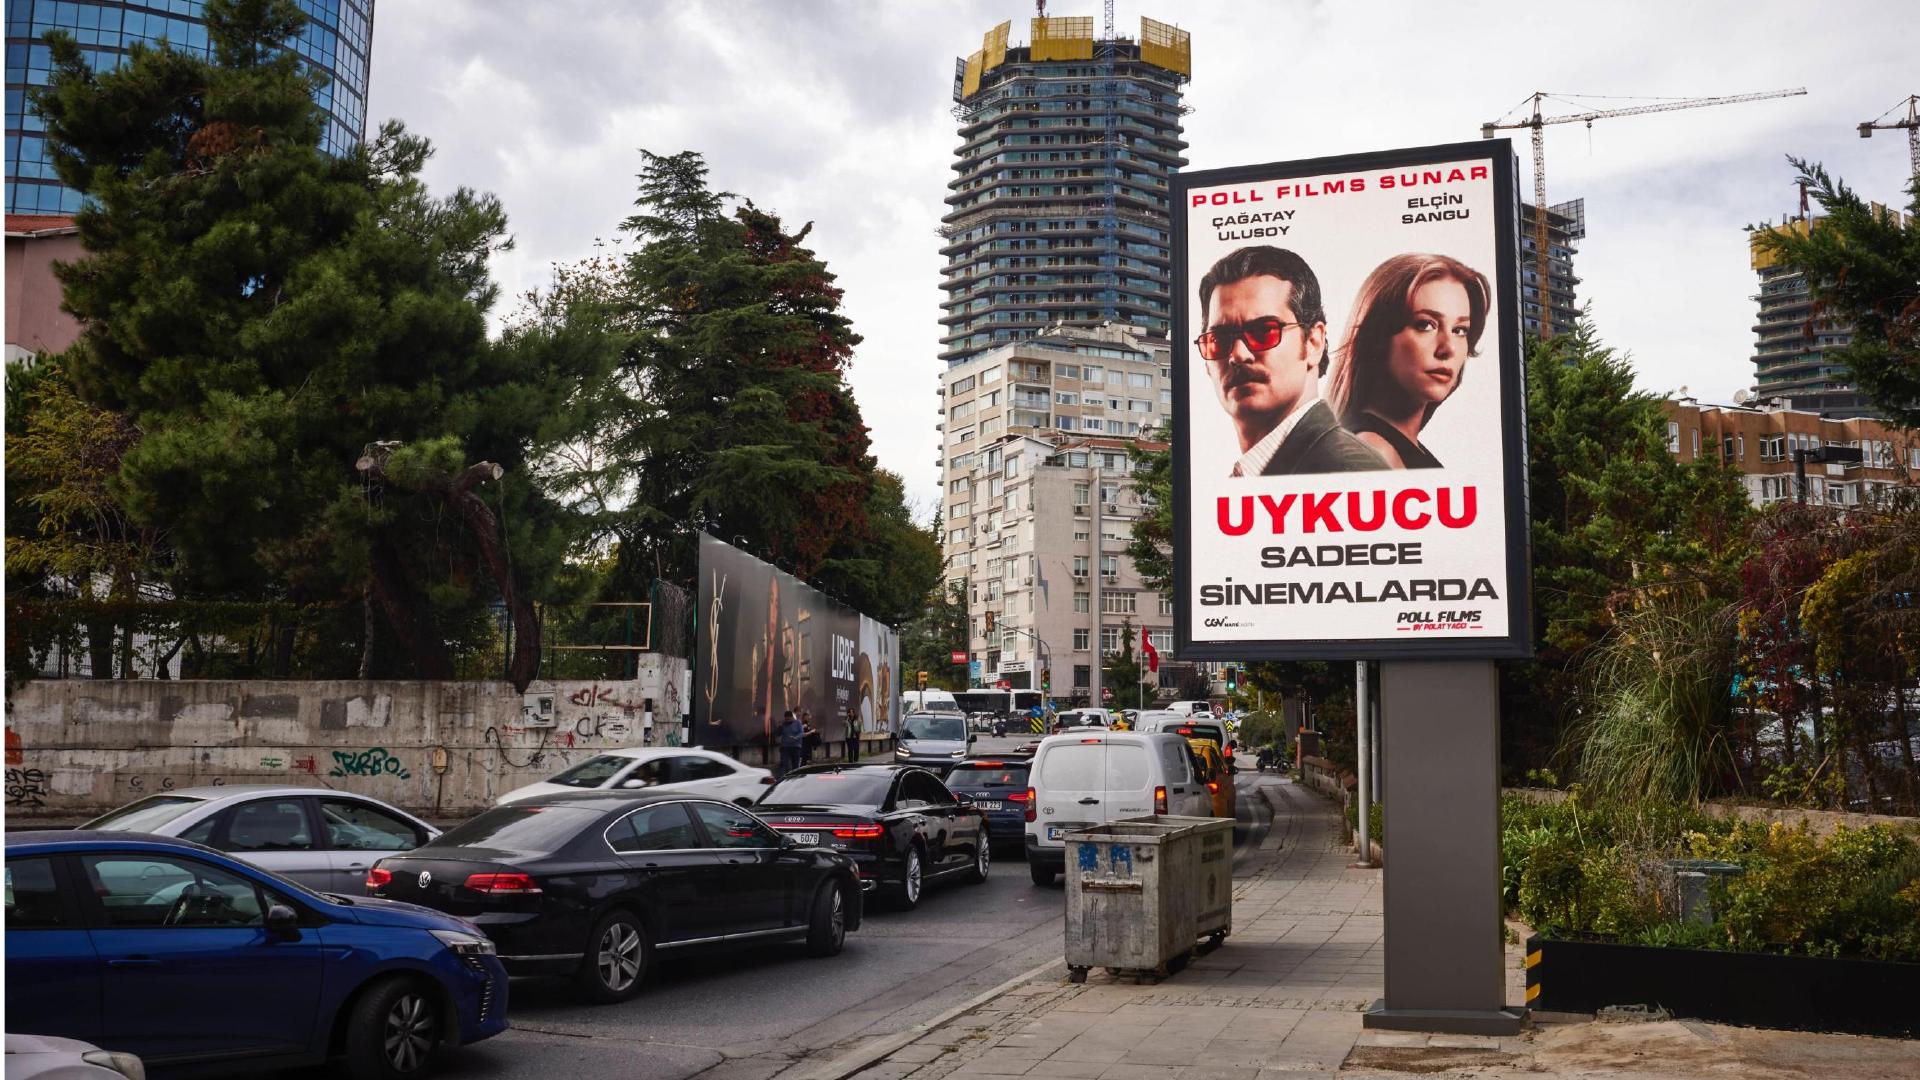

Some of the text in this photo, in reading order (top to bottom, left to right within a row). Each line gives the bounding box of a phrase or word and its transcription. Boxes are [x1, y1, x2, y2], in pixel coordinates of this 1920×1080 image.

[1192, 165, 1488, 208] POLL FILMS SUNAR
[1407, 192, 1464, 210] ELÇİN
[1211, 209, 1296, 230] ÇAĞATAY
[1401, 208, 1470, 225] SANGU
[1217, 225, 1291, 241] ULUSOY
[1216, 485, 1478, 537] UYKUCU
[1260, 542, 1423, 568] SADECE
[1204, 617, 1225, 627] CGV
[1396, 610, 1482, 623] POLL FILMS
[831, 633, 855, 682] LIBRE
